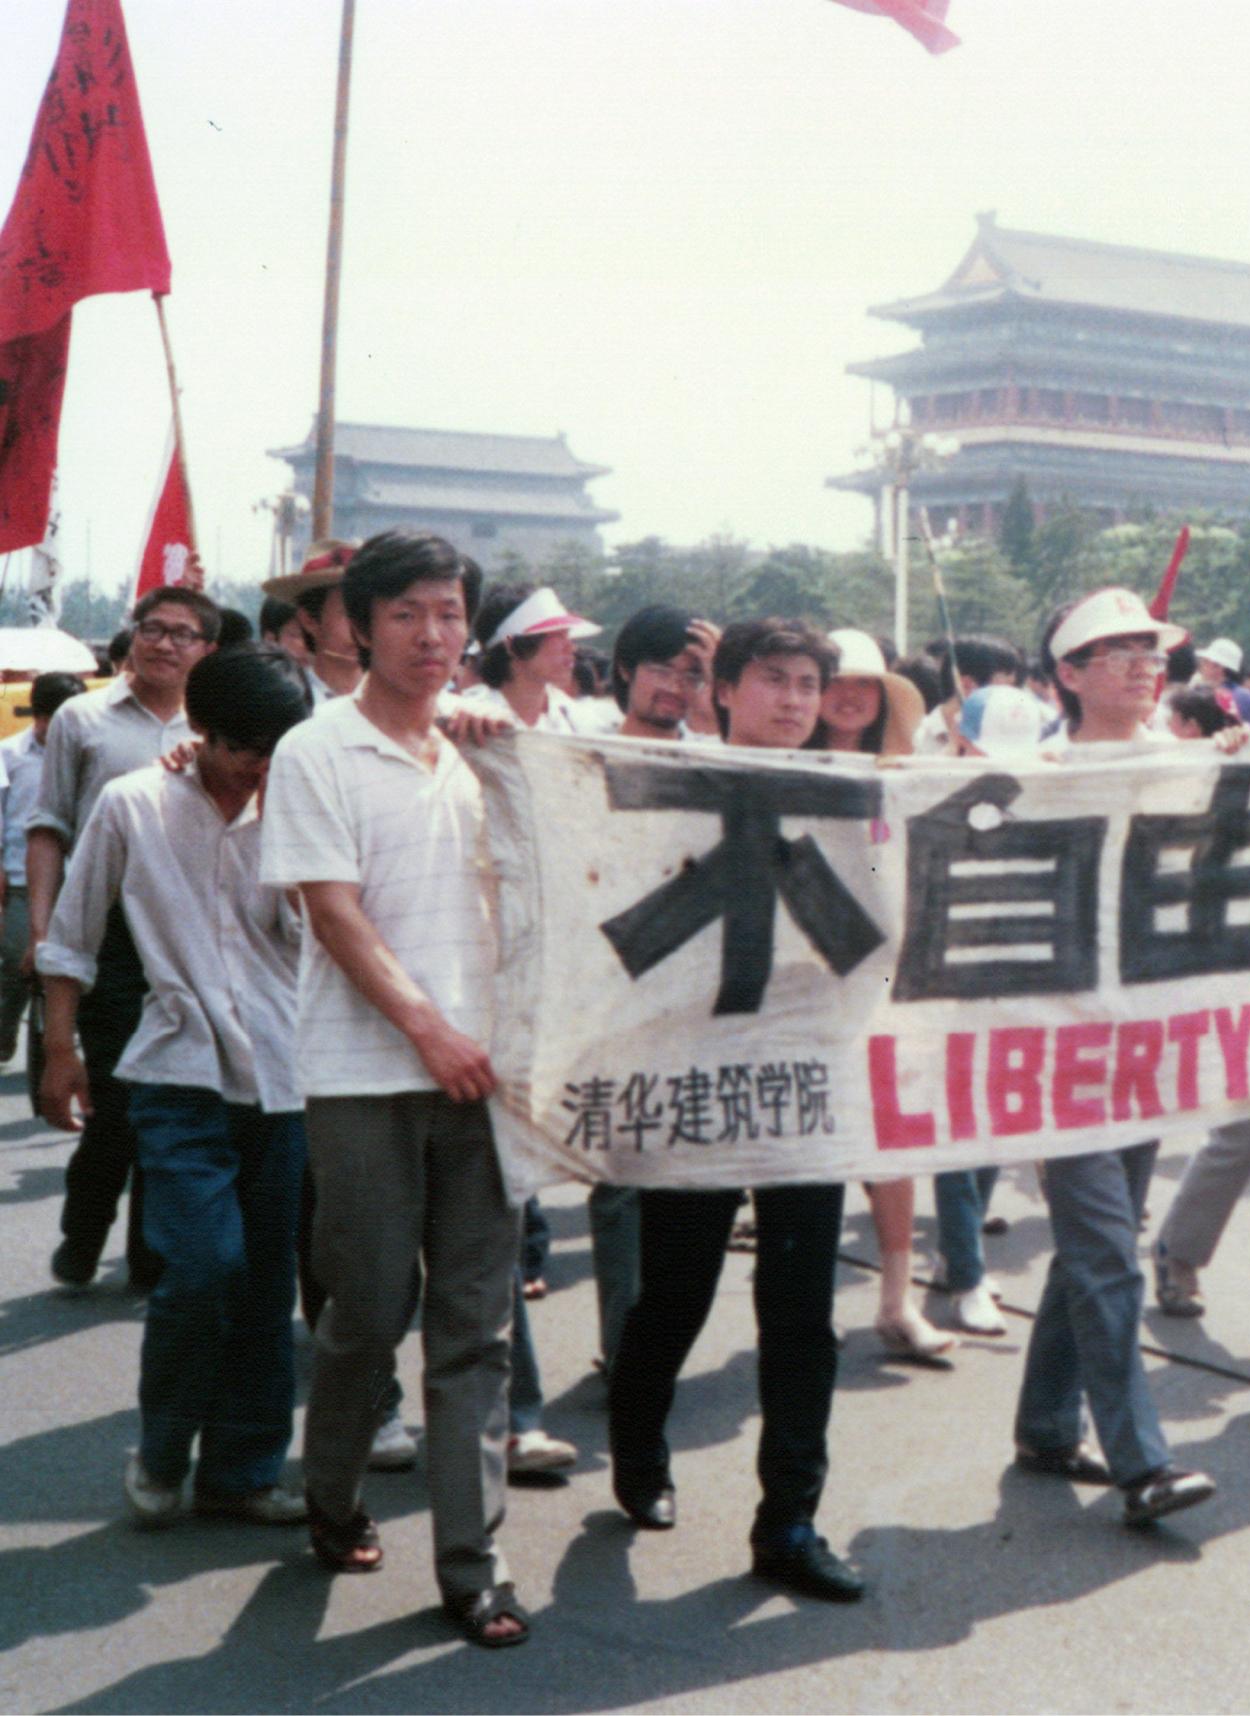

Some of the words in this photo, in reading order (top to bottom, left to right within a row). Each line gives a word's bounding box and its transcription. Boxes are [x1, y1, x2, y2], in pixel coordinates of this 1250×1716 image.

[562, 1059, 835, 1152] 清华建筑学院
